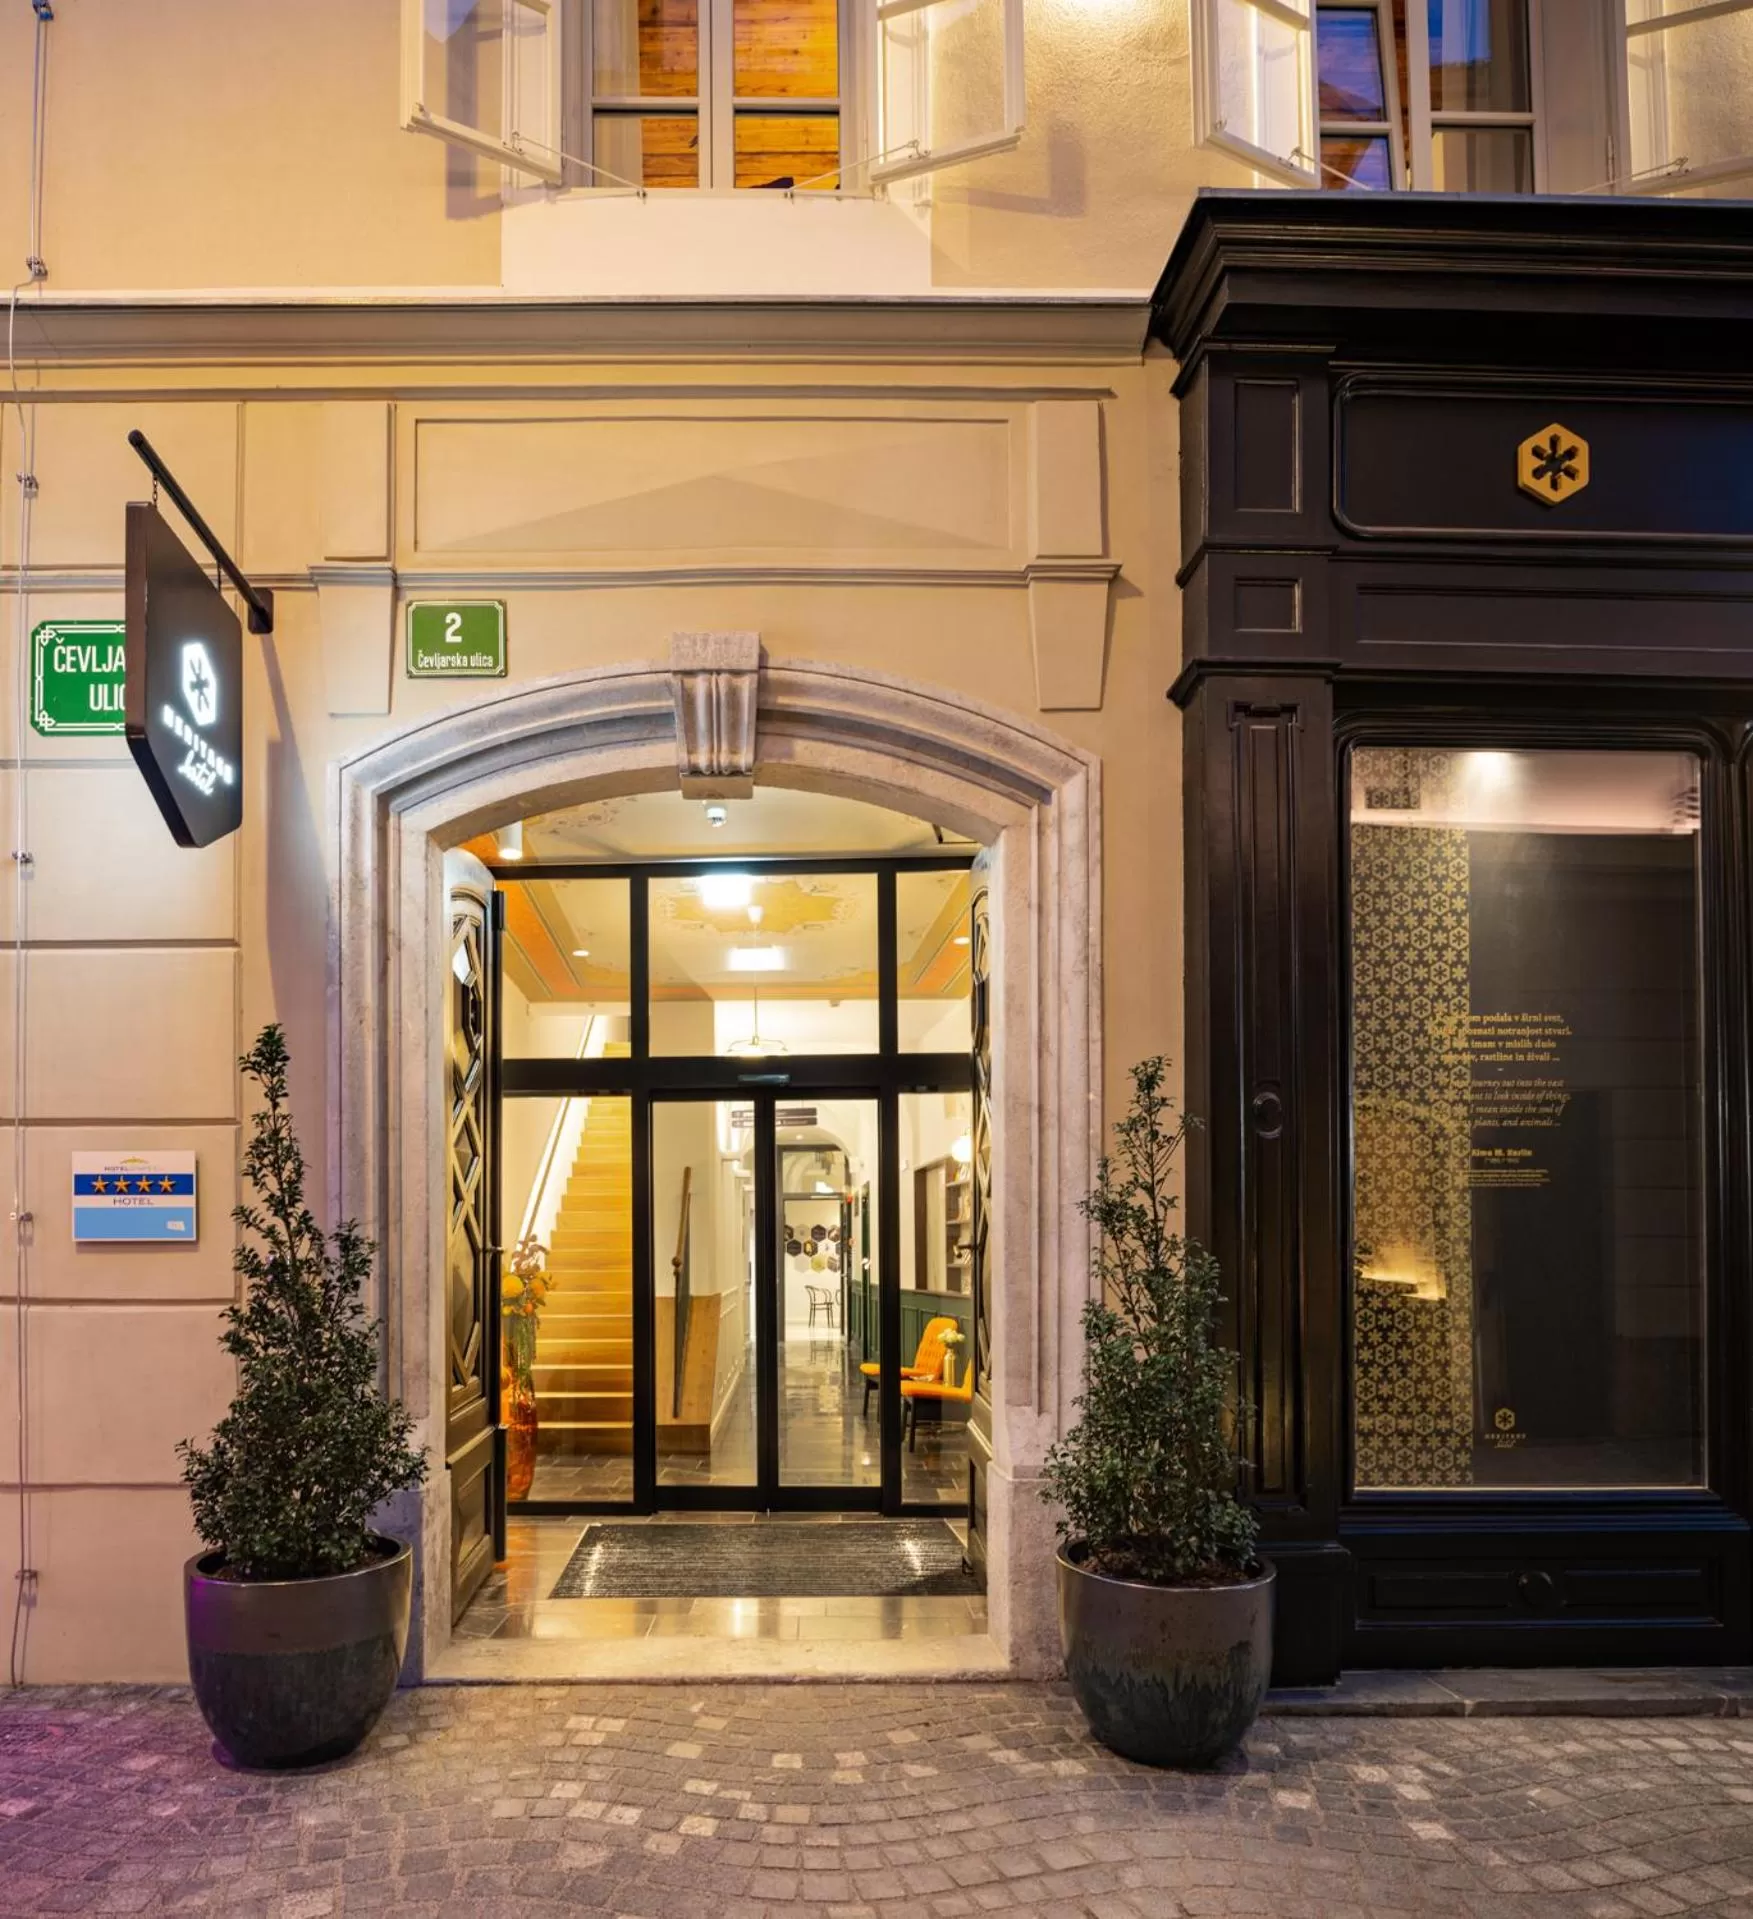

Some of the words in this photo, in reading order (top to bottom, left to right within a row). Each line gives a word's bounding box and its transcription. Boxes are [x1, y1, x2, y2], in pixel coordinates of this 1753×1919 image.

[445, 612, 462, 642] 2
[53, 637, 126, 672] ČEVLJA
[418, 649, 468, 669] Čevljarska
[470, 652, 494, 667] ulica
[1483, 1012, 1512, 1025] podala
[1497, 1026, 1543, 1037] notranjost
[1480, 1052, 1514, 1061] rastline
[1502, 1116, 1519, 1126] and
[112, 1197, 154, 1206] HOTEL
